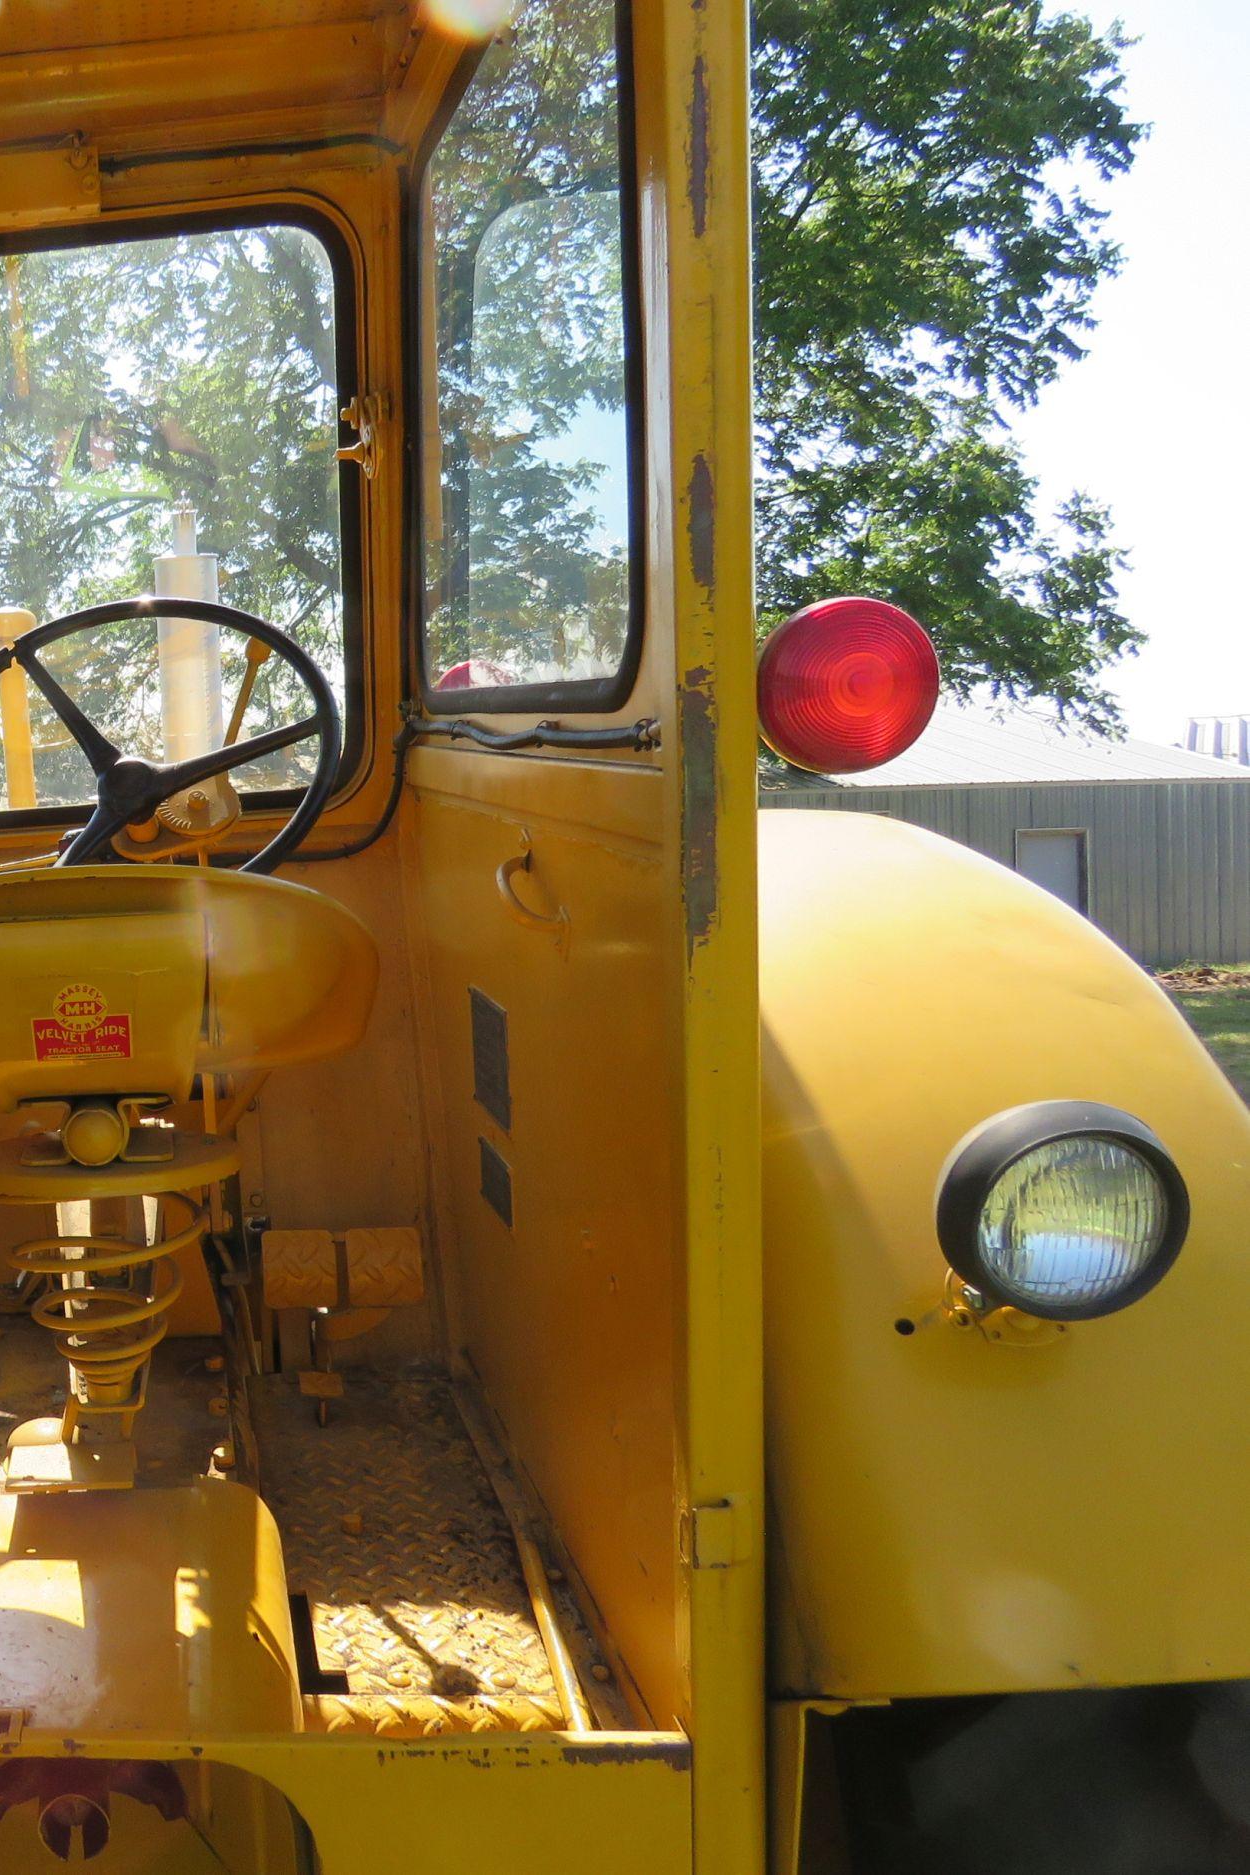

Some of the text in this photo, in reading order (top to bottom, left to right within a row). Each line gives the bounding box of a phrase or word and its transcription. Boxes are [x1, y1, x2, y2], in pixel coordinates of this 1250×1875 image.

[59, 984, 102, 1001] MASSEY
[60, 1016, 103, 1030] HARRIS
[37, 1025, 127, 1043] VELVET RIDE
